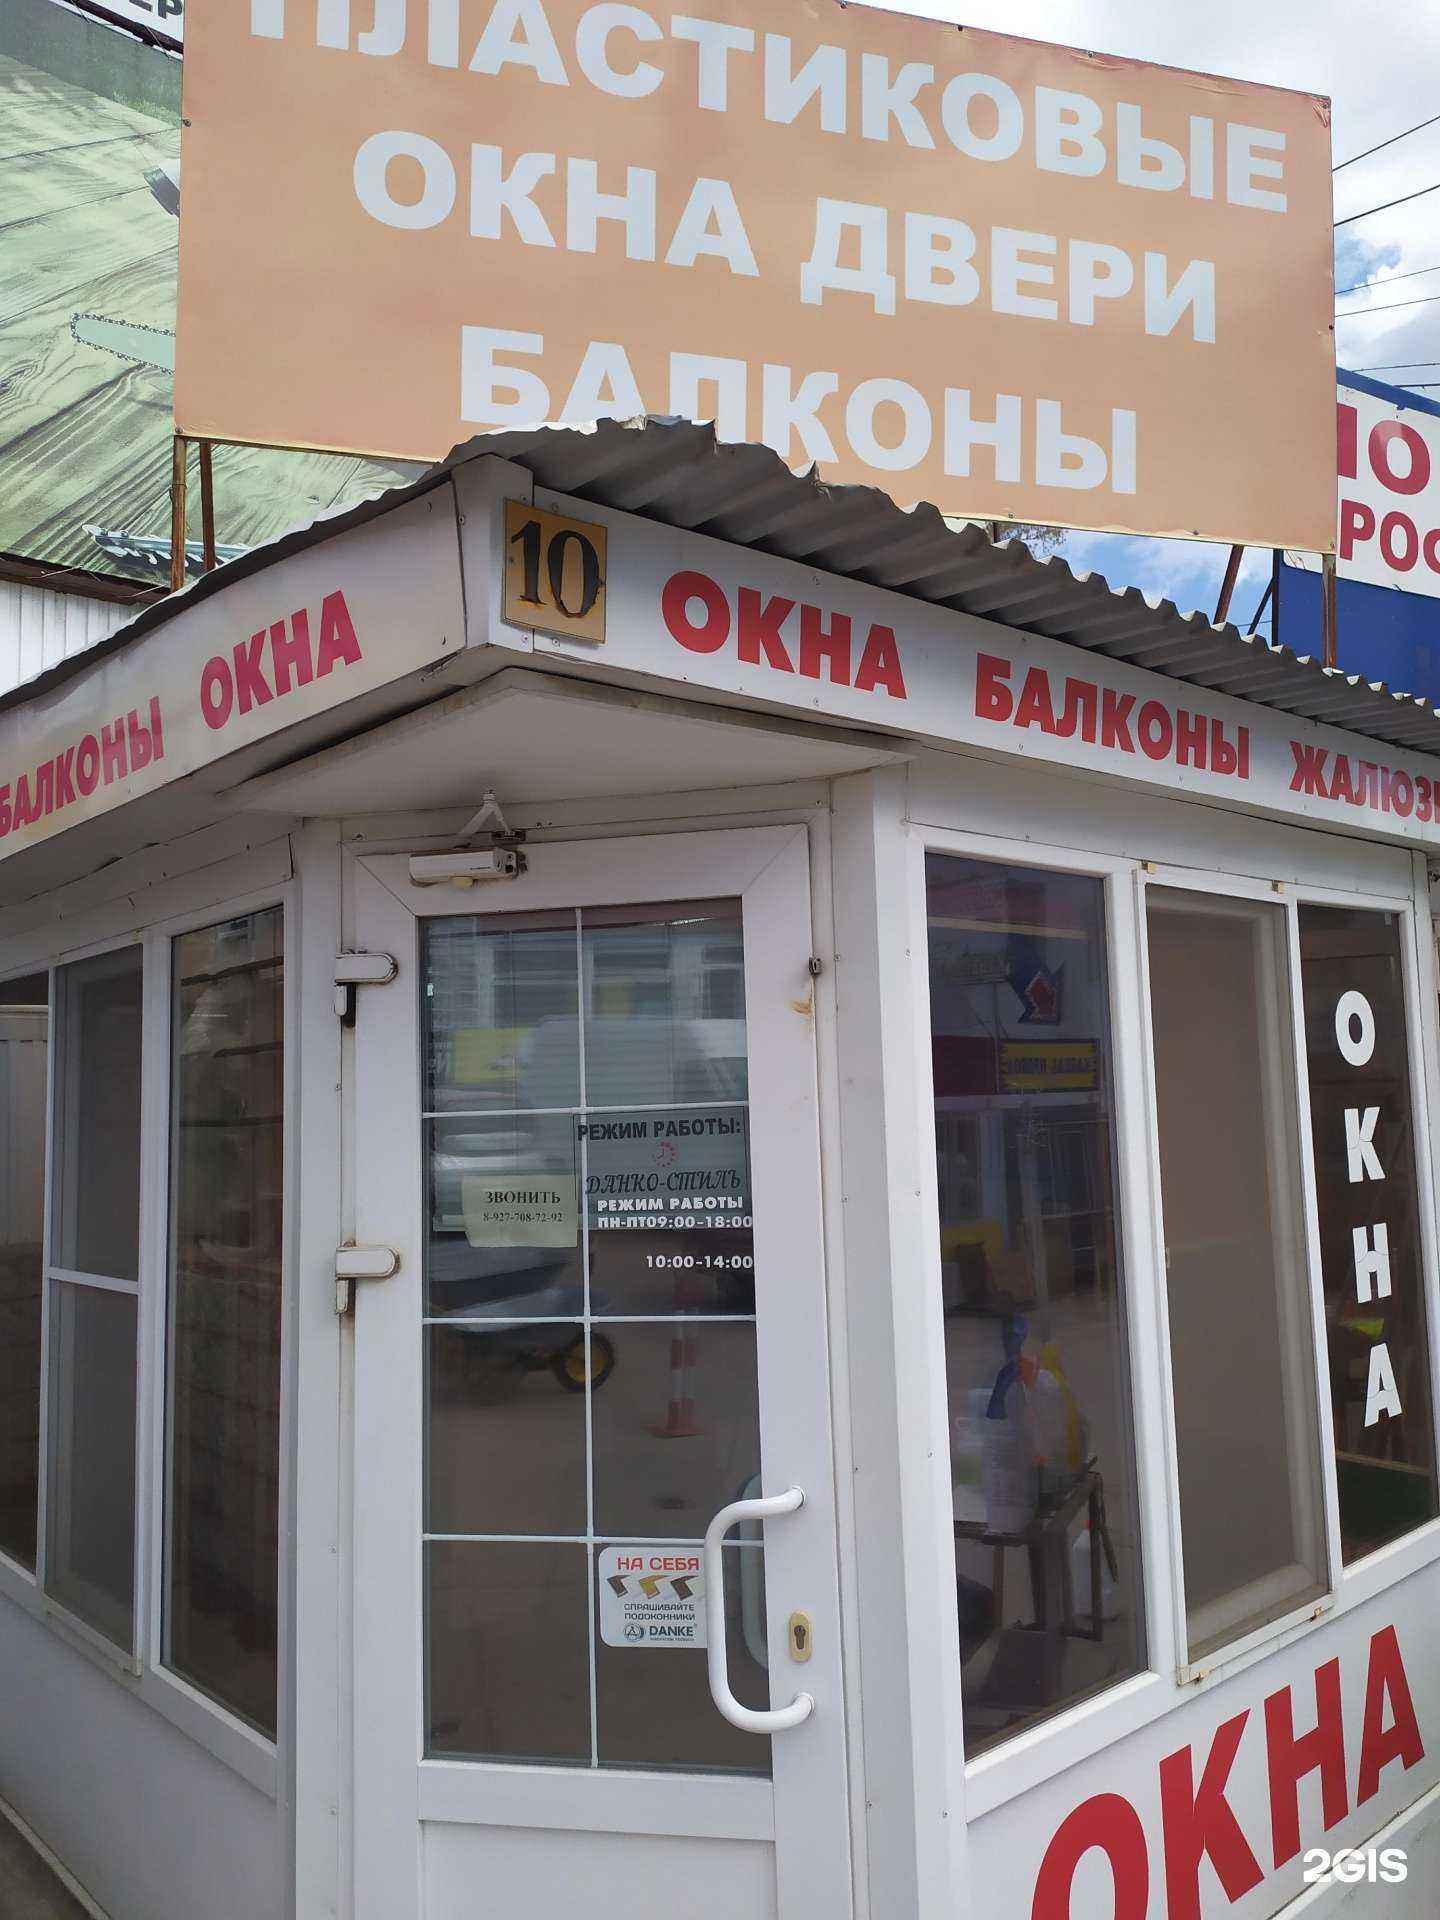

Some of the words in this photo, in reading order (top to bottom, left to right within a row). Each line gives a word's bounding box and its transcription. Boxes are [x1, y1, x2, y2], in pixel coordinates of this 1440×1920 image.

[353, 131, 760, 277] ОКНА
[800, 197, 1216, 344] ДВЕРИ
[509, 519, 602, 619] 10
[662, 570, 907, 700] ОКНА
[974, 652, 1251, 779] БАЛКОНЫ
[0, 696, 164, 838] БАЛКОНЫ
[200, 590, 362, 730] ОКНА
[577, 1121, 647, 1141] РЕЖИМ
[653, 1117, 742, 1138] РАБОТЫ:
[485, 1191, 561, 1204] ЗВОНИТЬ
[597, 1198, 664, 1212] РЕЖИМ
[669, 1196, 743, 1210] РАБОТЫ
[483, 1212, 563, 1223] 8-927-708-72-92
[646, 1255, 753, 1270] 10:00-14:00
[617, 1557, 643, 1570] НА
[649, 1557, 700, 1571] СЕБЯ
[624, 1601, 695, 1612] СПРАШИВАЙТЕ
[624, 1612, 696, 1621] ПОДОКОННИКИ
[649, 1625, 695, 1637] DANKE
[1030, 1624, 1426, 1920] ОКНА
